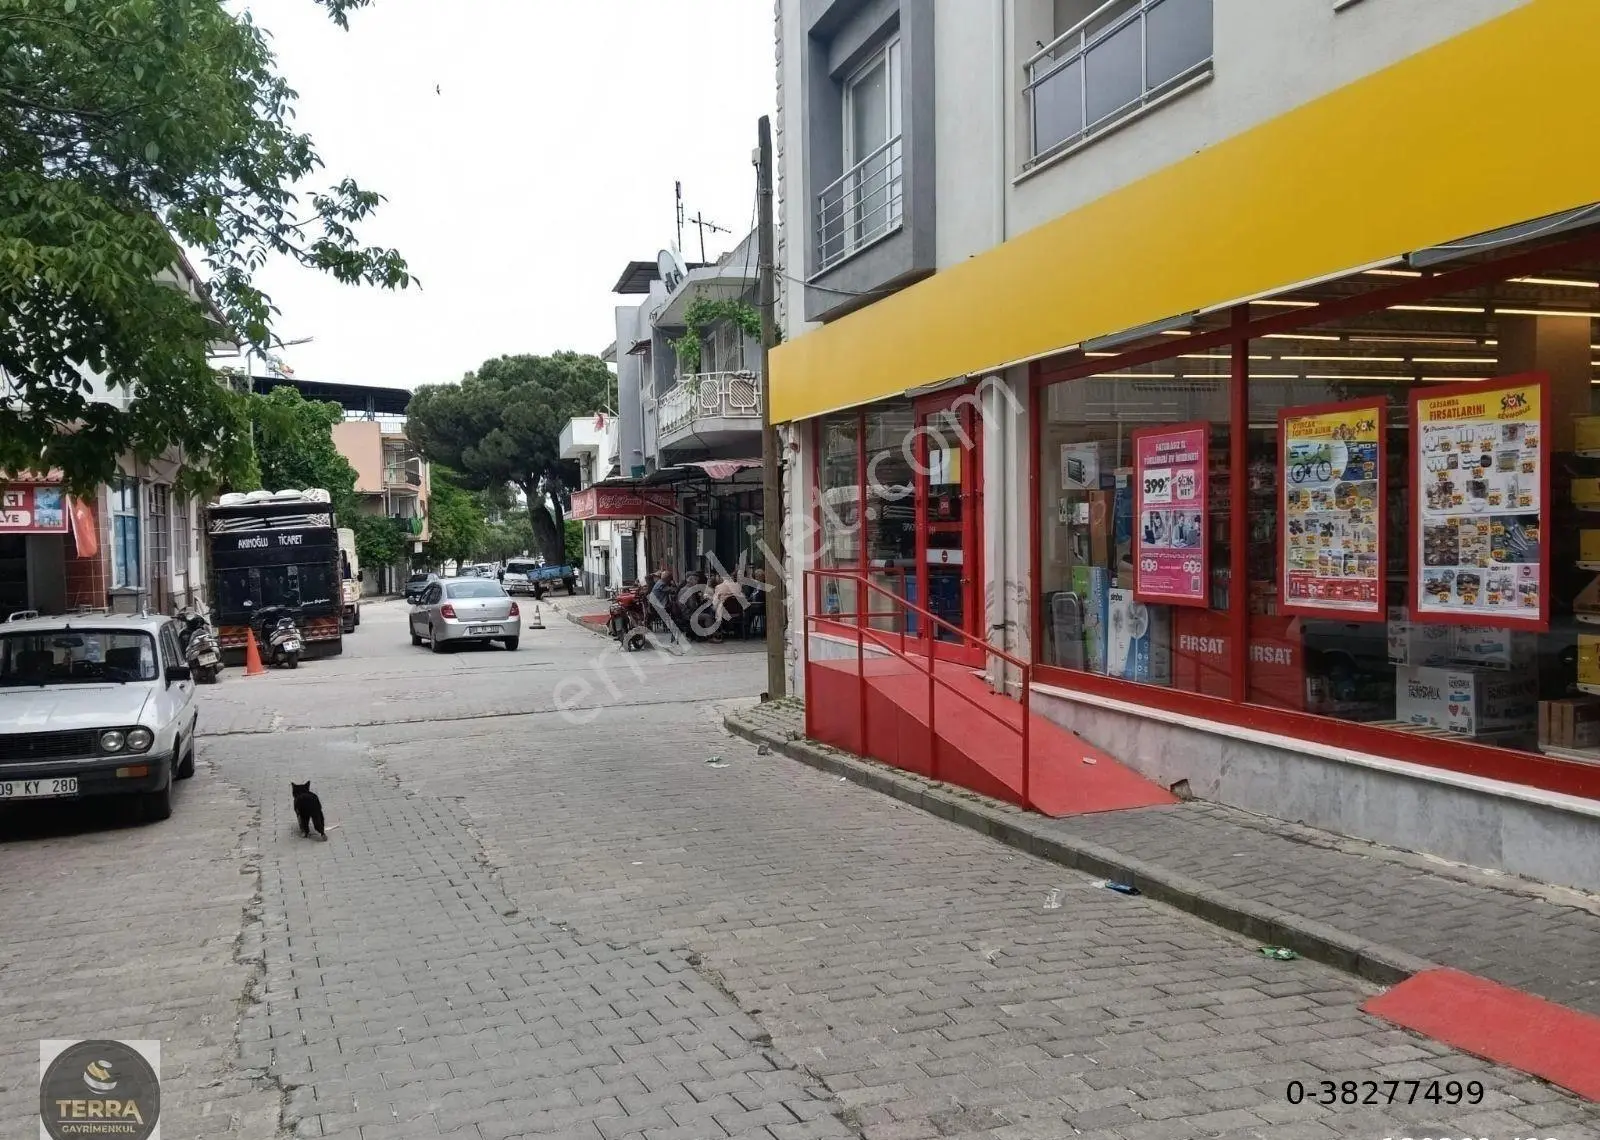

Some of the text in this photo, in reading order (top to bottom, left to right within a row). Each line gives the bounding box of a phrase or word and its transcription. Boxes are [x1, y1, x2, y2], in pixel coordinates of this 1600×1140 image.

[1429, 404, 1486, 420] FIRSATLARINI
[277, 533, 303, 546] TİCARET
[1180, 634, 1225, 654] FIRSAT
[1249, 644, 1293, 666] IRSAT
[24, 780, 40, 795] KY
[52, 778, 77, 793] 280
